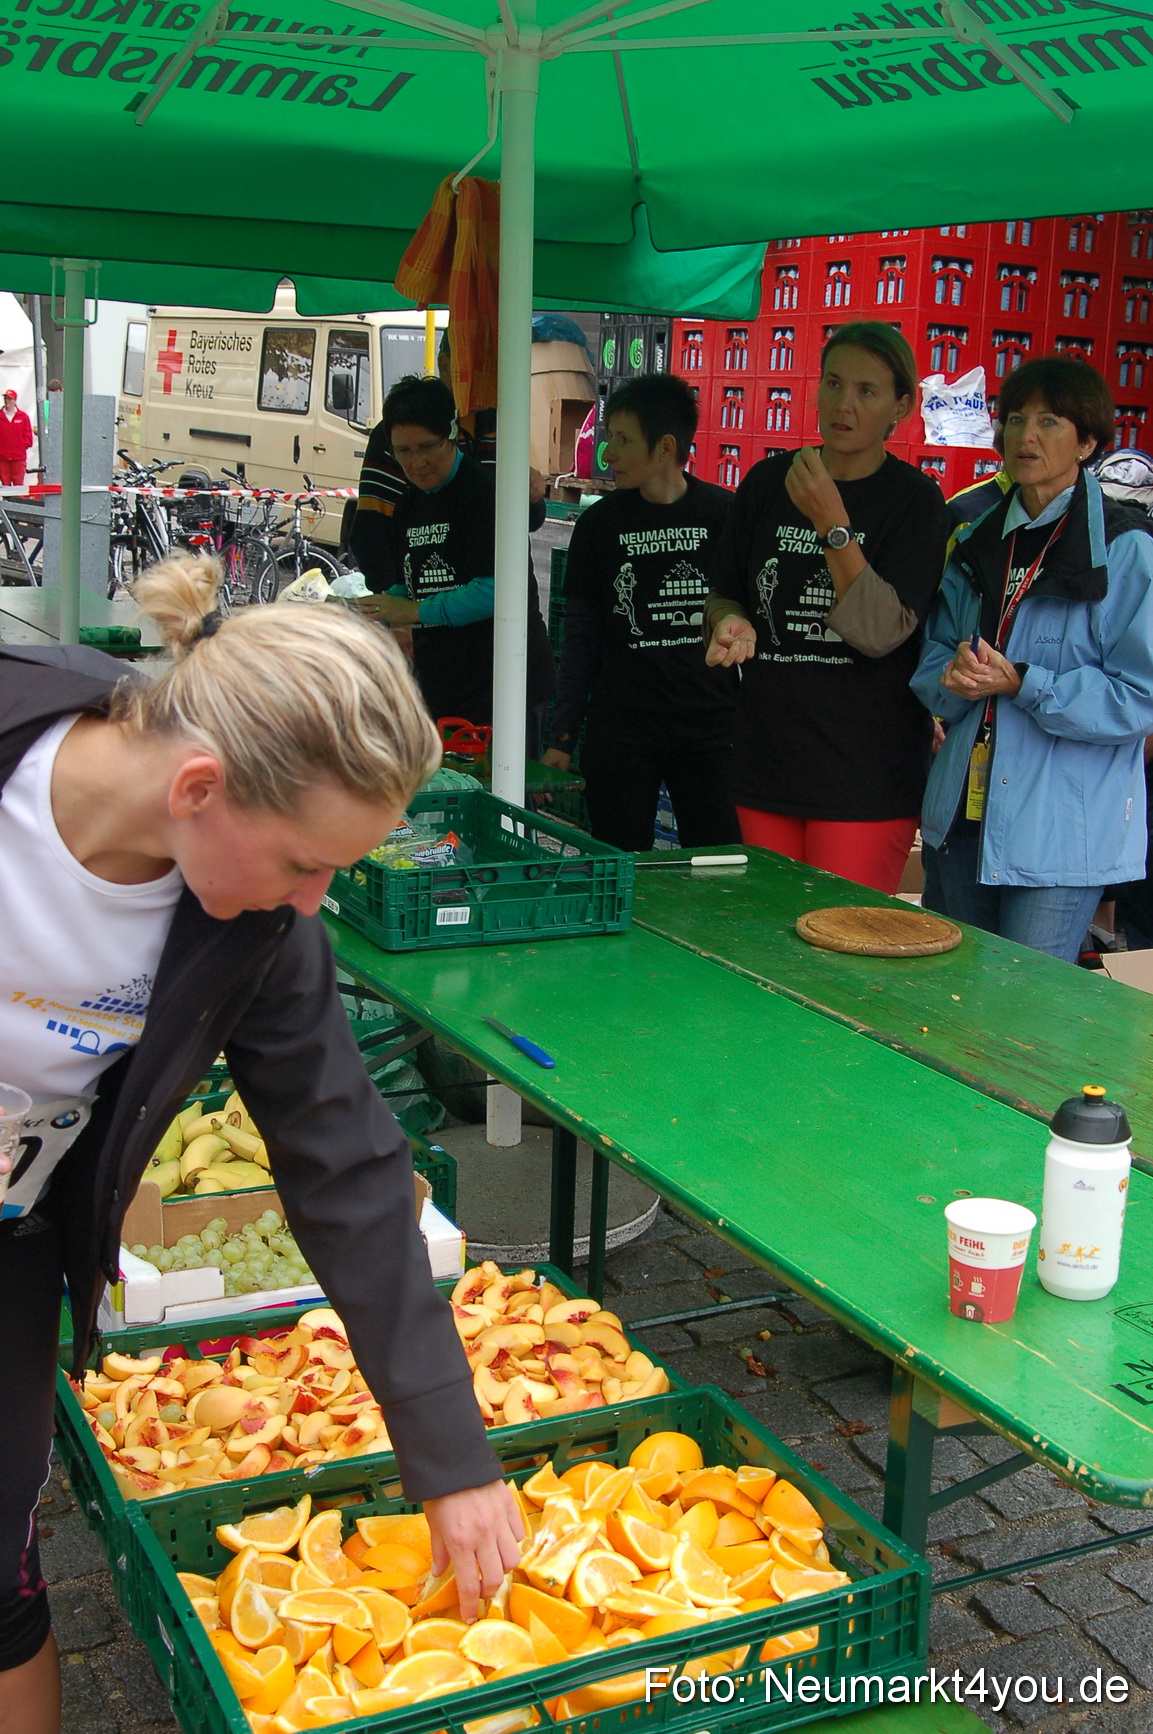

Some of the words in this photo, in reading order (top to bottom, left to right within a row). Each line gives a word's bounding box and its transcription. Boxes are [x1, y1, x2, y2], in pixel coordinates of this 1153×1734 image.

[190, 330, 253, 353] Bayerisches
[187, 354, 217, 375] Rotes
[185, 378, 214, 400] Kreuz
[619, 527, 708, 545] NEUMARKTER
[627, 539, 701, 556] STADTLAUF
[640, 640, 660, 648] Euer
[773, 653, 793, 662] Euer
[11, 991, 47, 1013] 14.
[48, 1001, 121, 1023] Neumarkter
